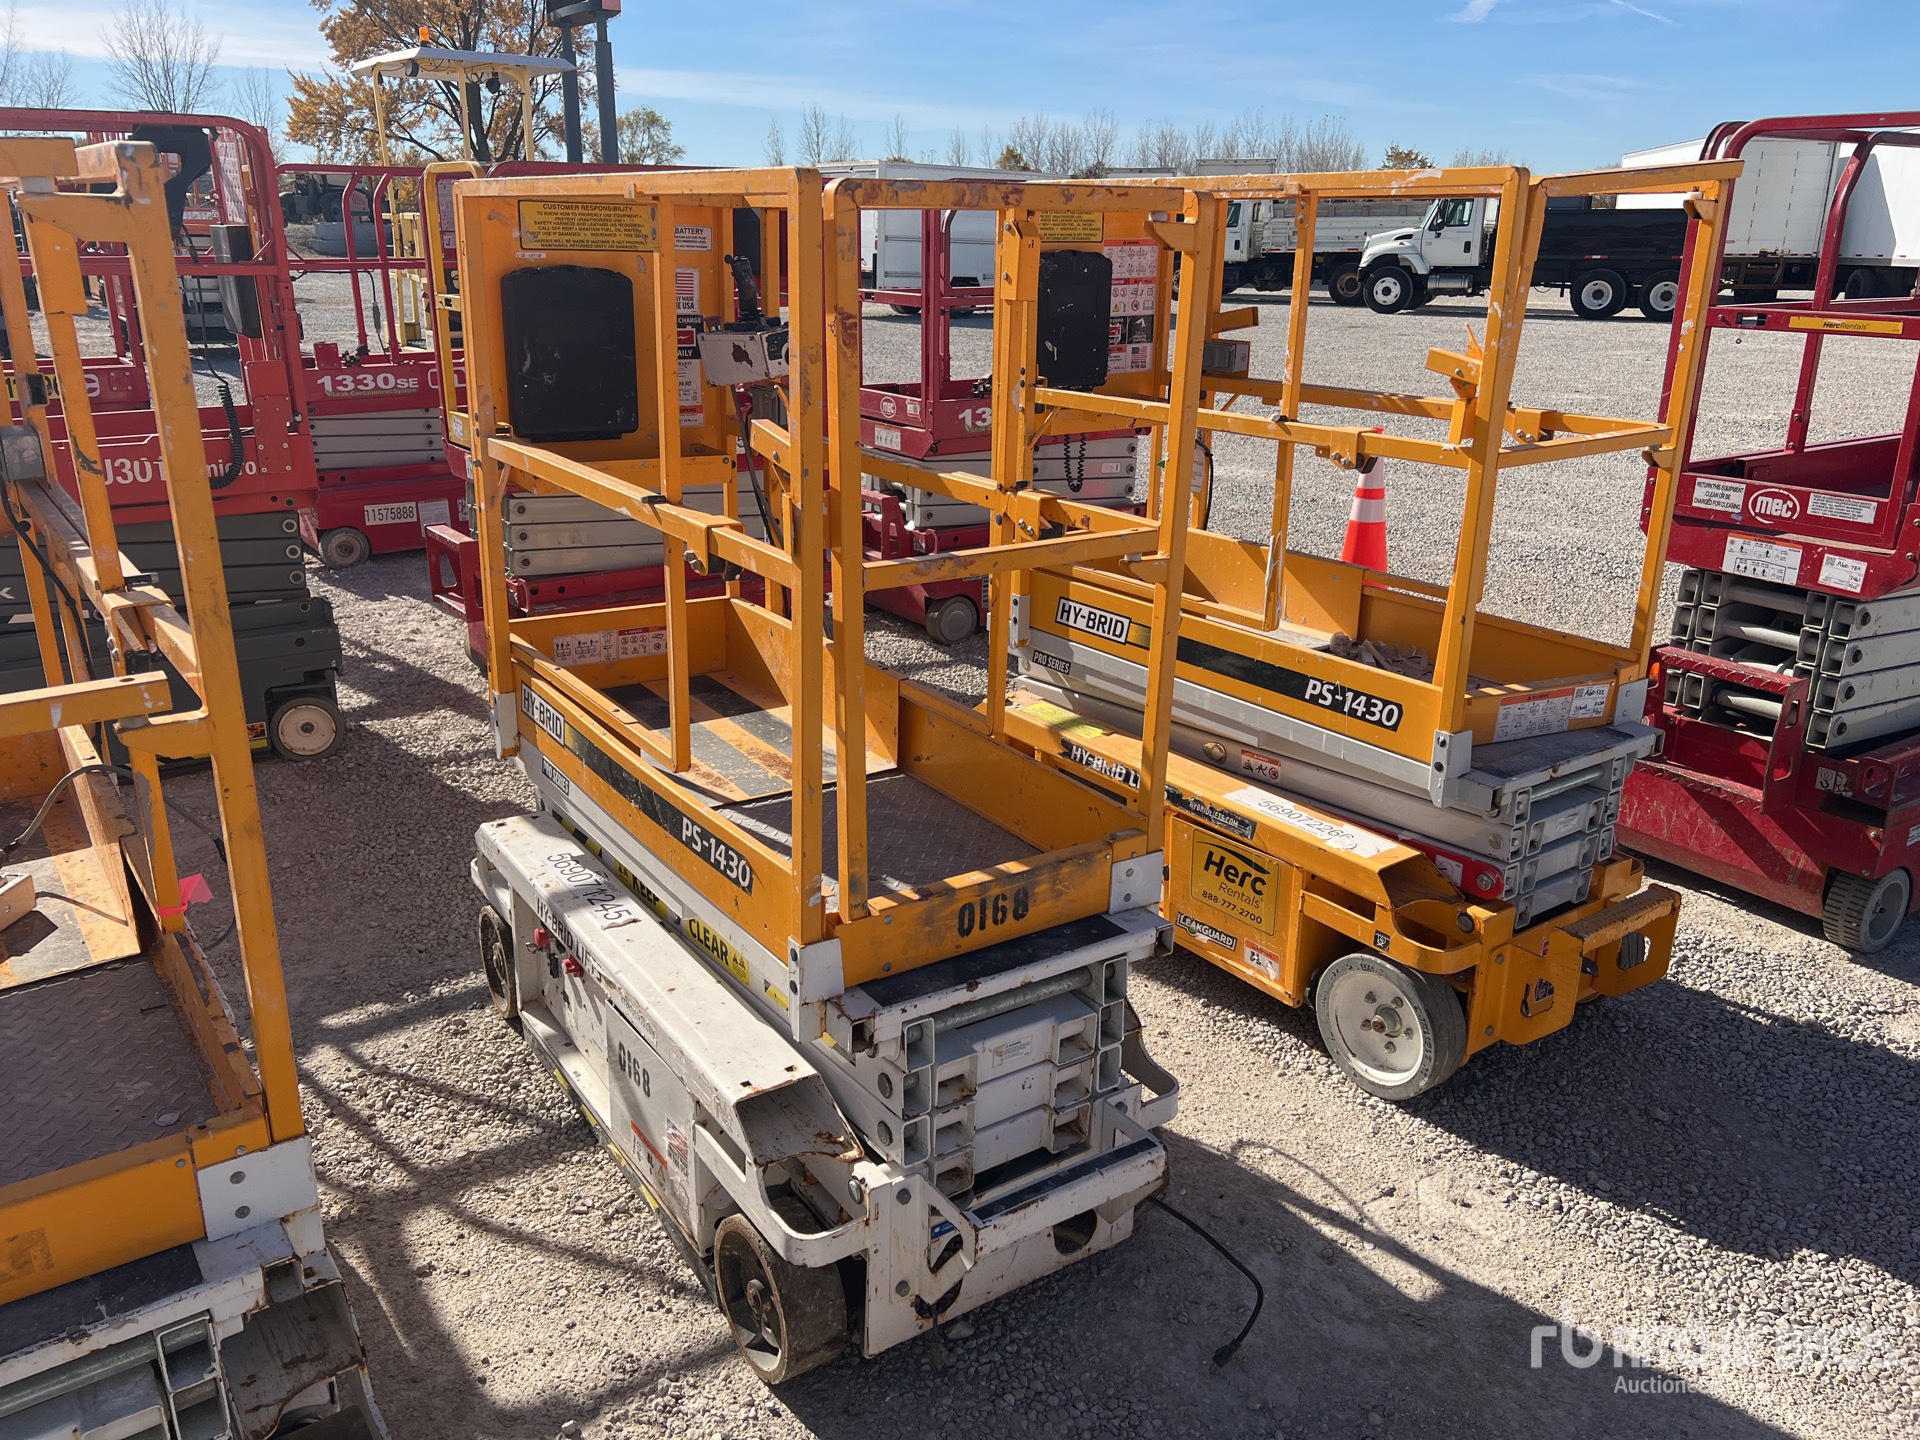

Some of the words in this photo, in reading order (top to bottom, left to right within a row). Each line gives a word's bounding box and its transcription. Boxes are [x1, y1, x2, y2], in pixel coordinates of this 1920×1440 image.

[580, 204, 632, 212] RESPONSIBILITY
[674, 227, 704, 235] BATTERY
[682, 302, 695, 310] USA
[1694, 498, 1712, 506] CHARGED
[1721, 502, 1741, 510] CLEANING
[1696, 481, 1712, 489] RETURN
[1721, 485, 1744, 494] EQUIPMENT
[365, 506, 415, 522] 11575888
[1755, 496, 1794, 518] mec
[1060, 602, 1125, 639] HY-BRID
[1034, 651, 1048, 665] PRO
[1048, 655, 1070, 674] SERIES
[524, 688, 562, 740] HY-BRID
[1304, 678, 1399, 727] PS-1430
[1070, 744, 1126, 782] HY-BRID
[552, 769, 569, 793] SERIES
[682, 816, 751, 888] PS-1430
[1203, 850, 1268, 896] Herc
[957, 886, 1030, 940] 0168
[1201, 890, 1264, 926] 888-777-2700
[1218, 881, 1261, 910] Rentals
[536, 896, 574, 950] HY-BRID
[1179, 914, 1235, 948] LEAKGUARD
[688, 918, 730, 967] CLEAR
[618, 1041, 652, 1098] 0168
